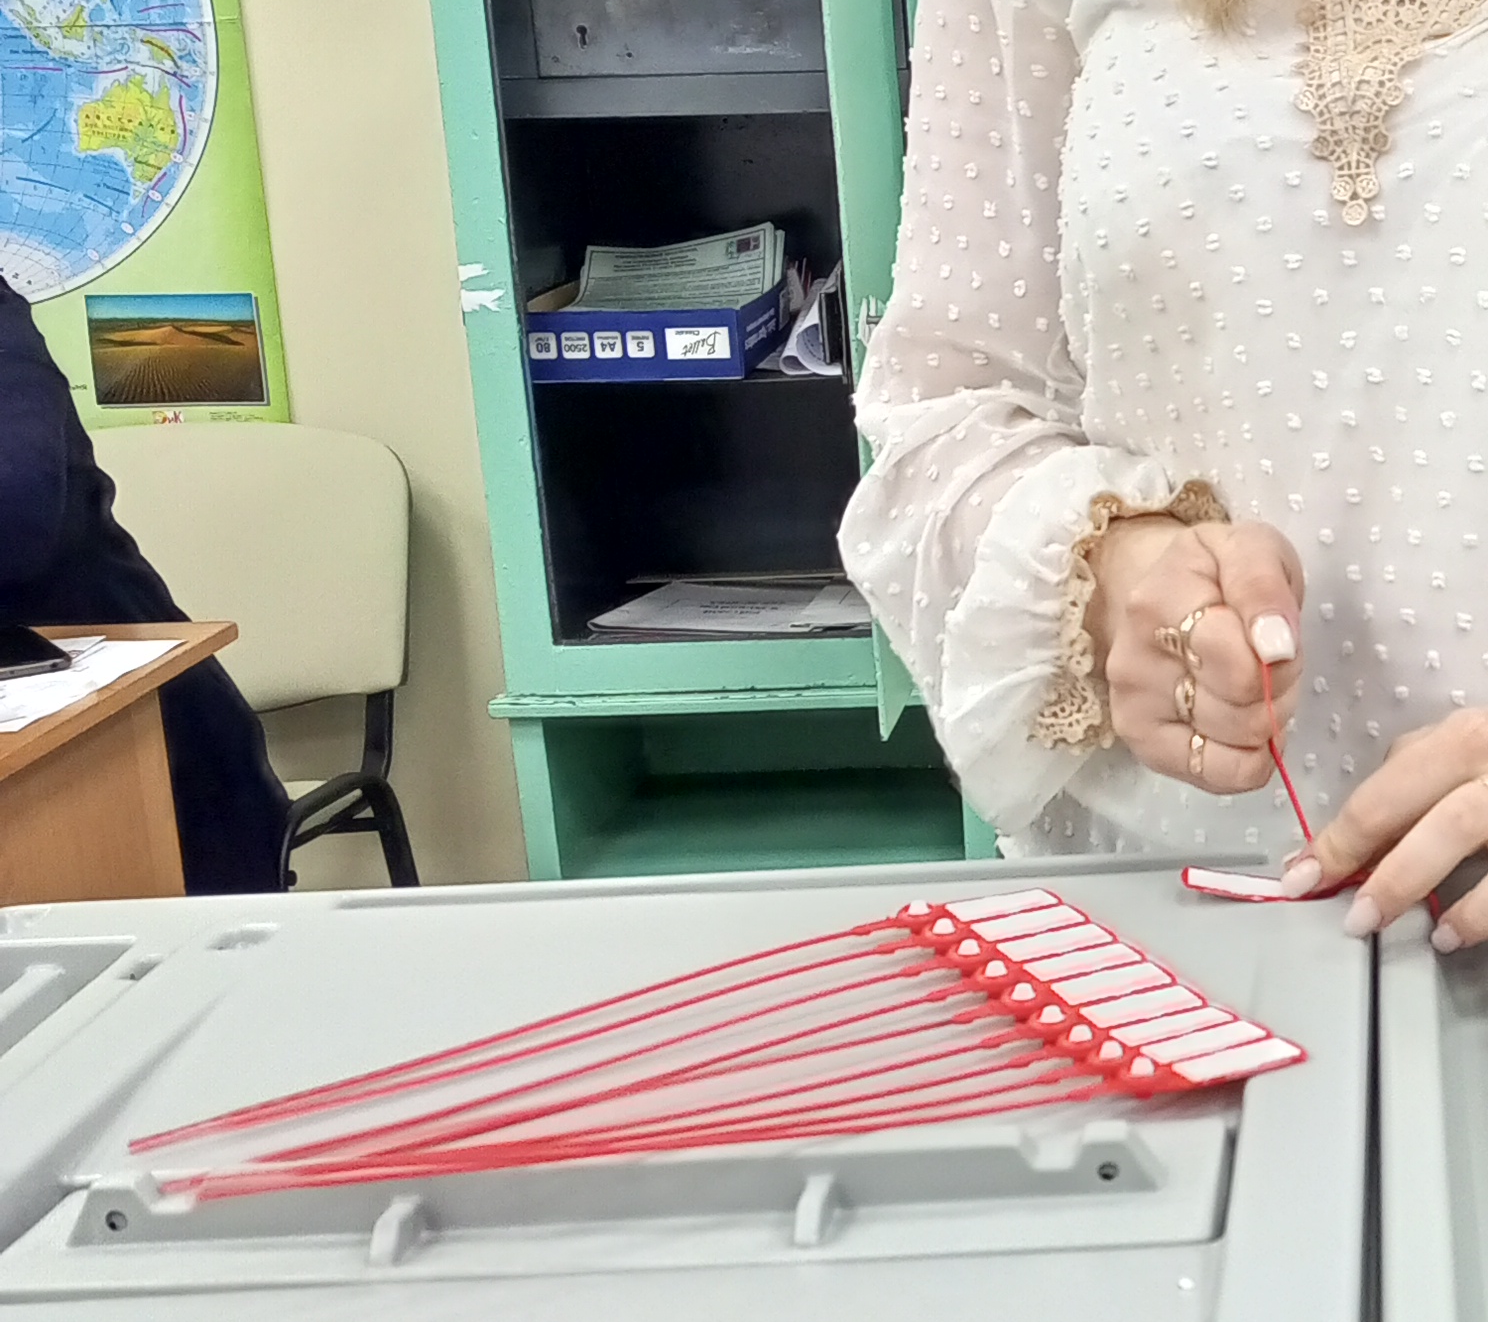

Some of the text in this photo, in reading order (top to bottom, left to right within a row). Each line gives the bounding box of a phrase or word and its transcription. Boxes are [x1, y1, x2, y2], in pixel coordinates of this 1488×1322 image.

[535, 342, 551, 353] 80
[564, 343, 588, 353] 2500
[600, 341, 617, 352] A4
[636, 341, 645, 352] 5
[680, 330, 722, 357] Ballet
